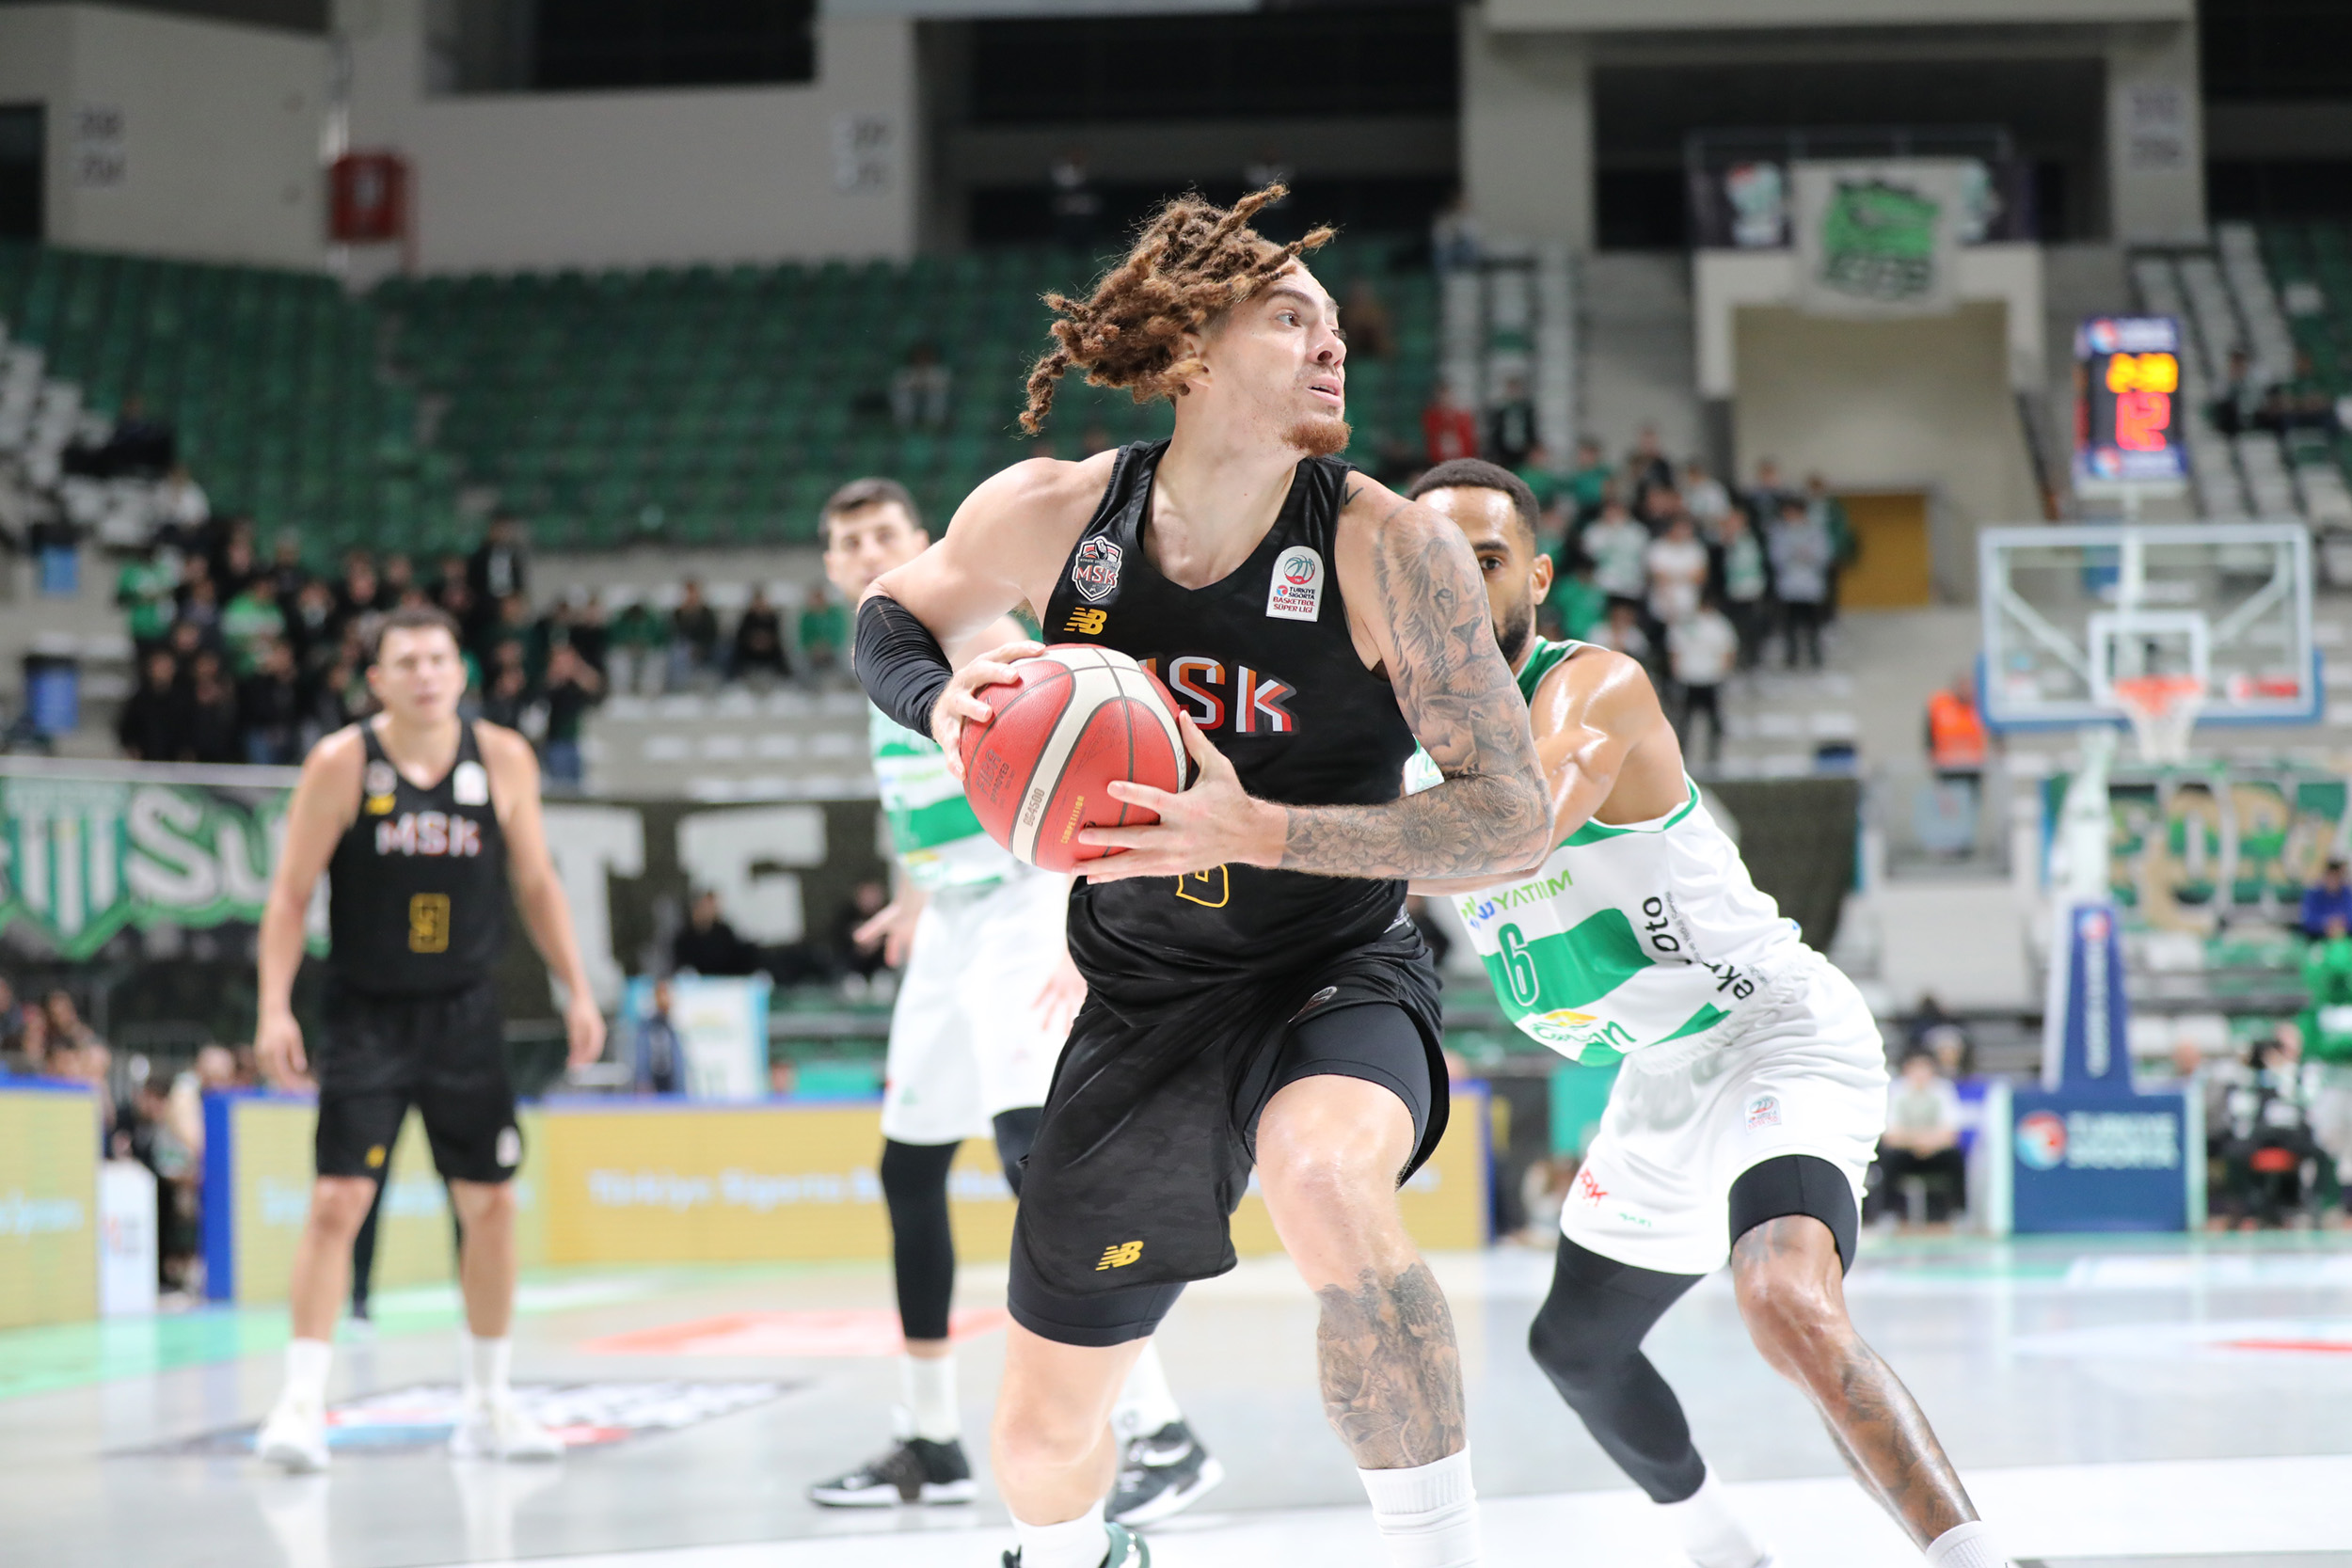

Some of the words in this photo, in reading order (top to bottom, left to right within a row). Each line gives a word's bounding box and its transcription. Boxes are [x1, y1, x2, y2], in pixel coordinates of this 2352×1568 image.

[1075, 564, 1117, 586] MSK
[1273, 596, 1316, 607] BASKETBOL
[1136, 656, 1293, 734] SK
[976, 749, 1002, 798] FIBA
[990, 762, 1009, 803] APPROVED
[375, 811, 483, 858] MSK
[1060, 795, 1085, 845] COMPETITION
[1642, 896, 1680, 952] Oto
[1497, 922, 1540, 1007] 6
